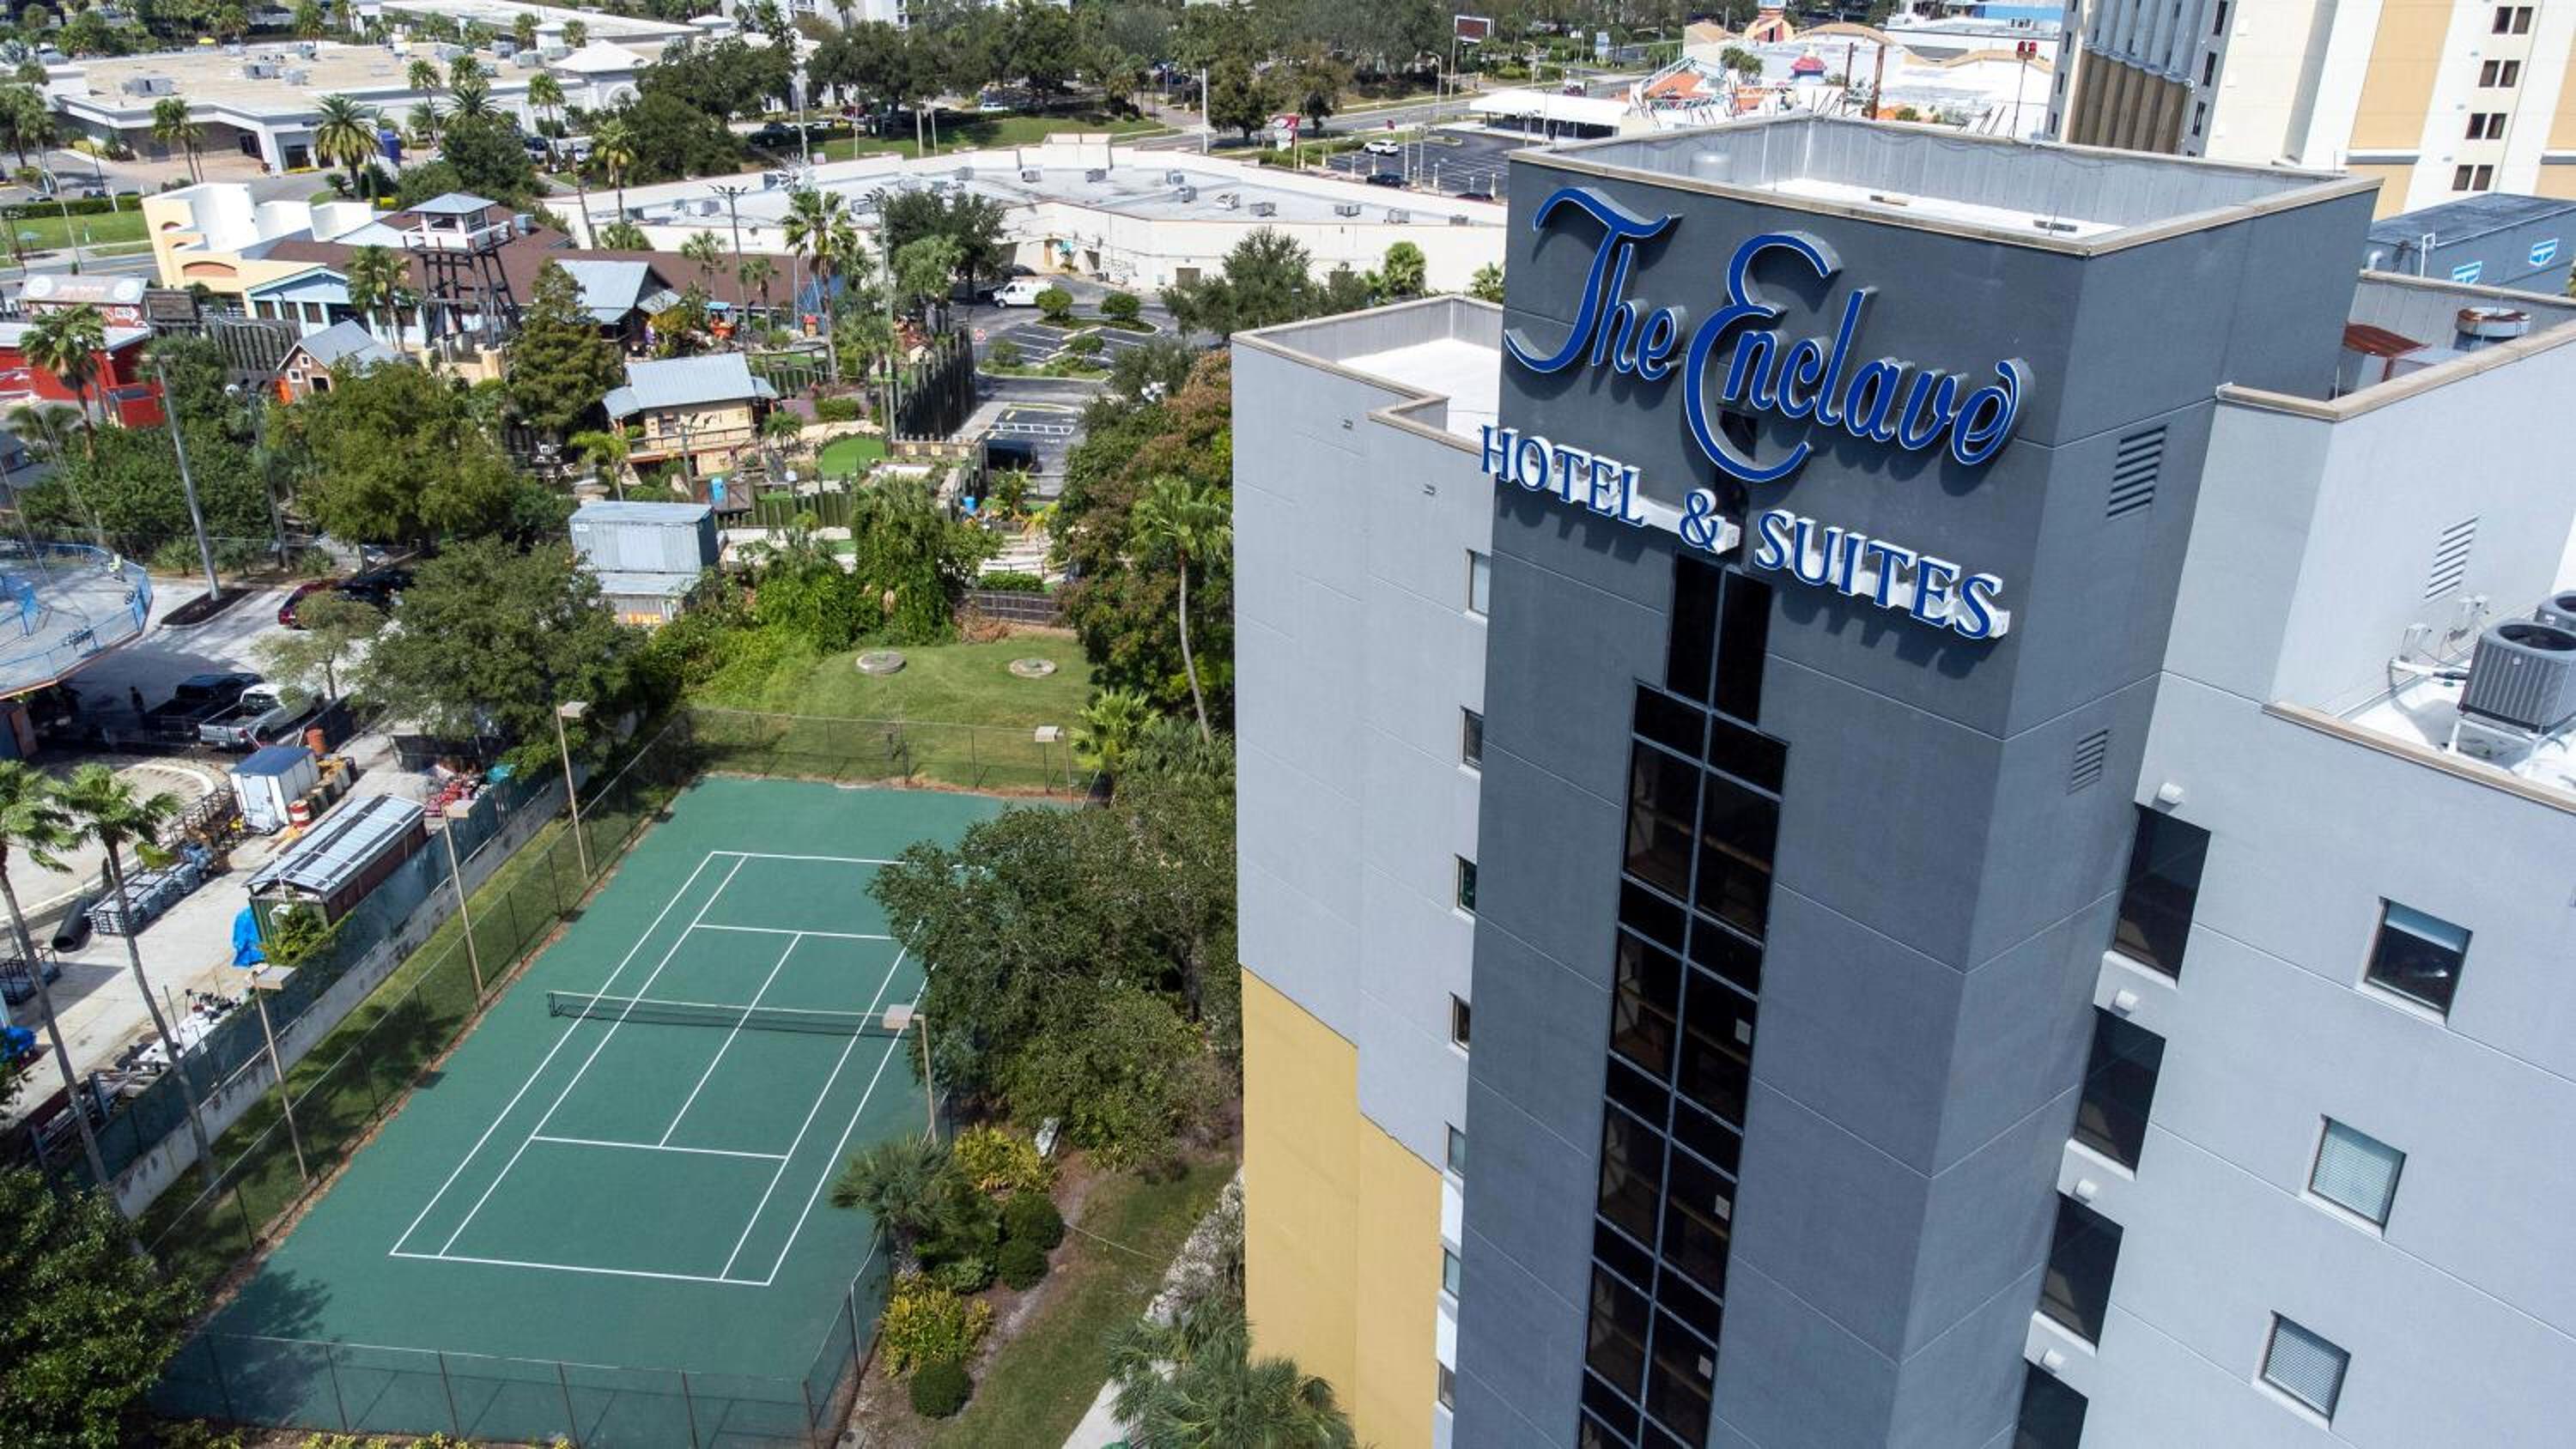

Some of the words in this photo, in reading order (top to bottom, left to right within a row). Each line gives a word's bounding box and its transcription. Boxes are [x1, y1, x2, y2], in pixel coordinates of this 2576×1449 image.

[1504, 185, 1676, 380] The
[1685, 232, 2020, 482] Enclave
[1482, 424, 1644, 526] HOTEL
[1679, 489, 1720, 551] &
[1755, 510, 2002, 640] SUITES
